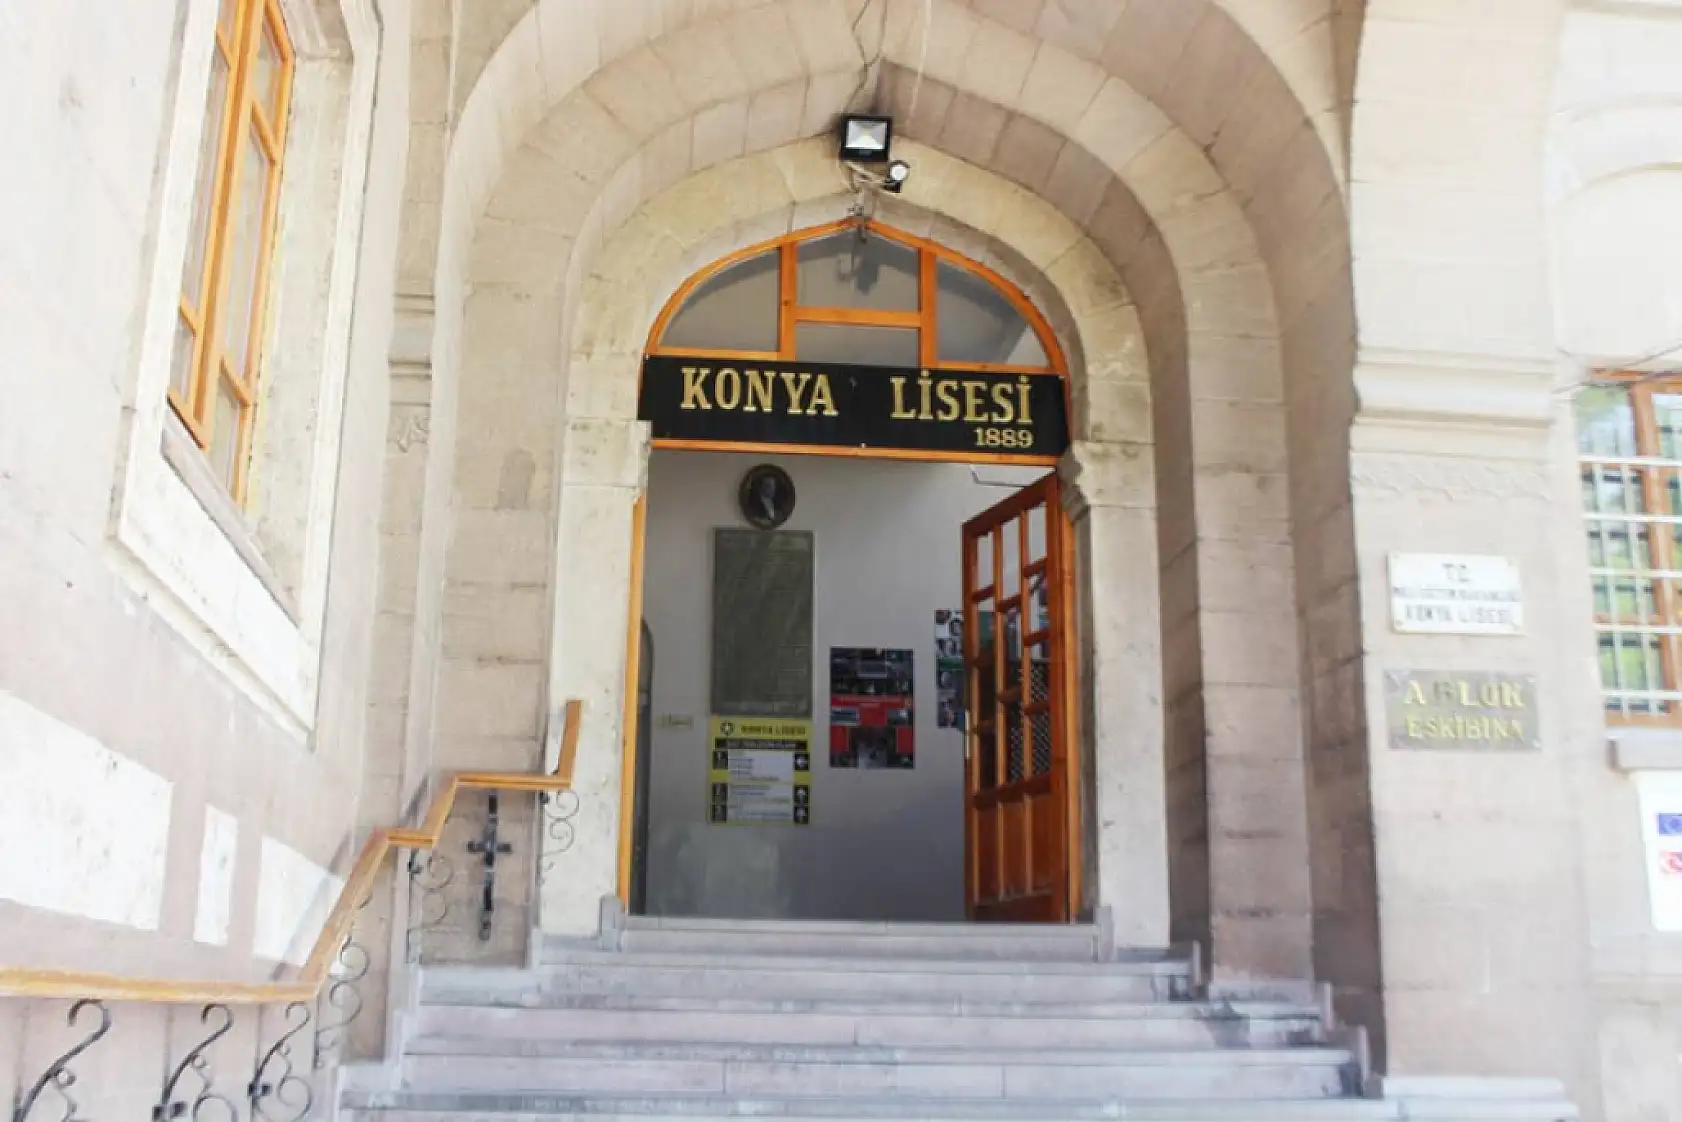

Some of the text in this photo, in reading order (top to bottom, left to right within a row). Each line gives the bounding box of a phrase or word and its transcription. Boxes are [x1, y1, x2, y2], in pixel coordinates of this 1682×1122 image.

[680, 366, 1033, 424] KONYA LİSESİ
[974, 427, 1034, 448] 1889
[1403, 679, 1427, 705] A
